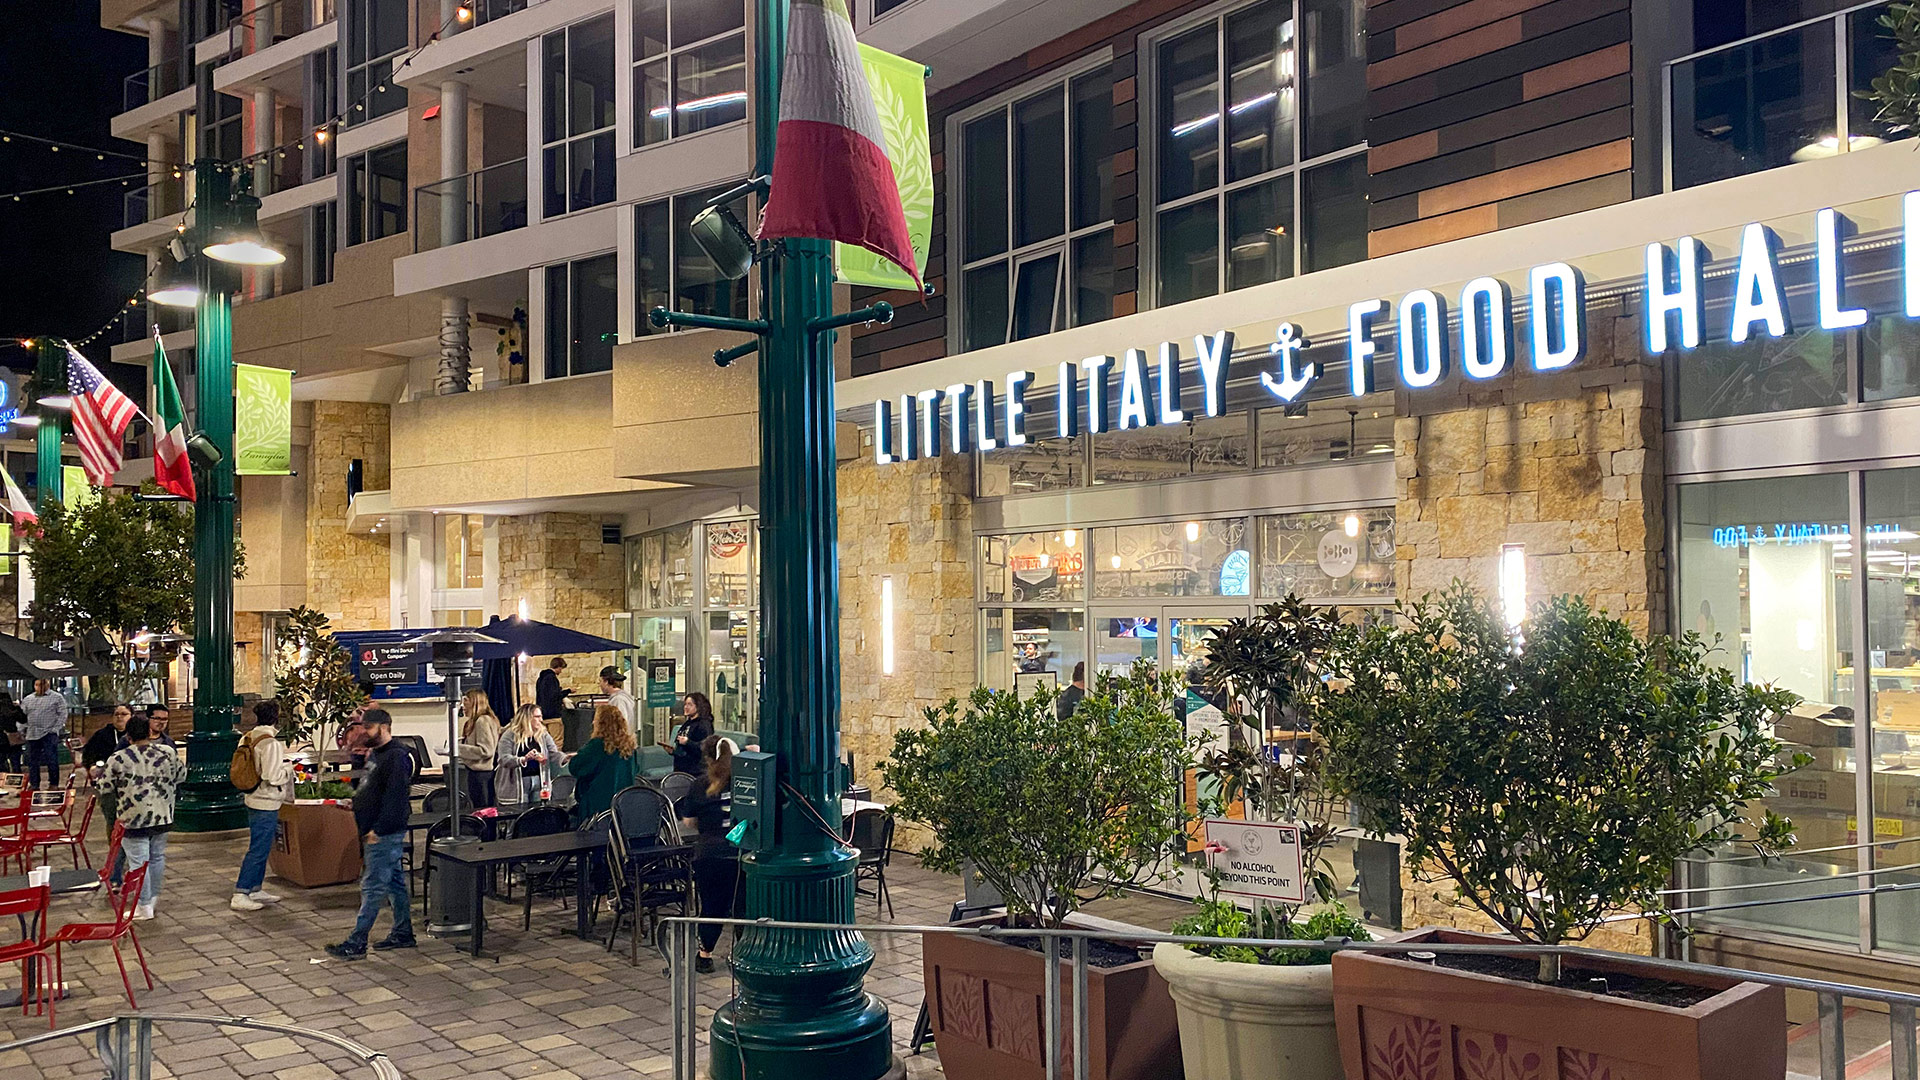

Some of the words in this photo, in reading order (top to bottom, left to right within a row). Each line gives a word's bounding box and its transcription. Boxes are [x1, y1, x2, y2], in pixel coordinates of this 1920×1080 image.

[875, 370, 1032, 465] LITTLE
[1058, 330, 1231, 439] ITALY
[1348, 261, 1583, 397] FOOD
[369, 672, 388, 681] Open
[389, 671, 406, 680] Daily
[1230, 861, 1242, 870] NO
[1242, 862, 1277, 873] ALCOHOL
[1249, 875, 1267, 885] THIS
[1267, 877, 1290, 887] POINT
